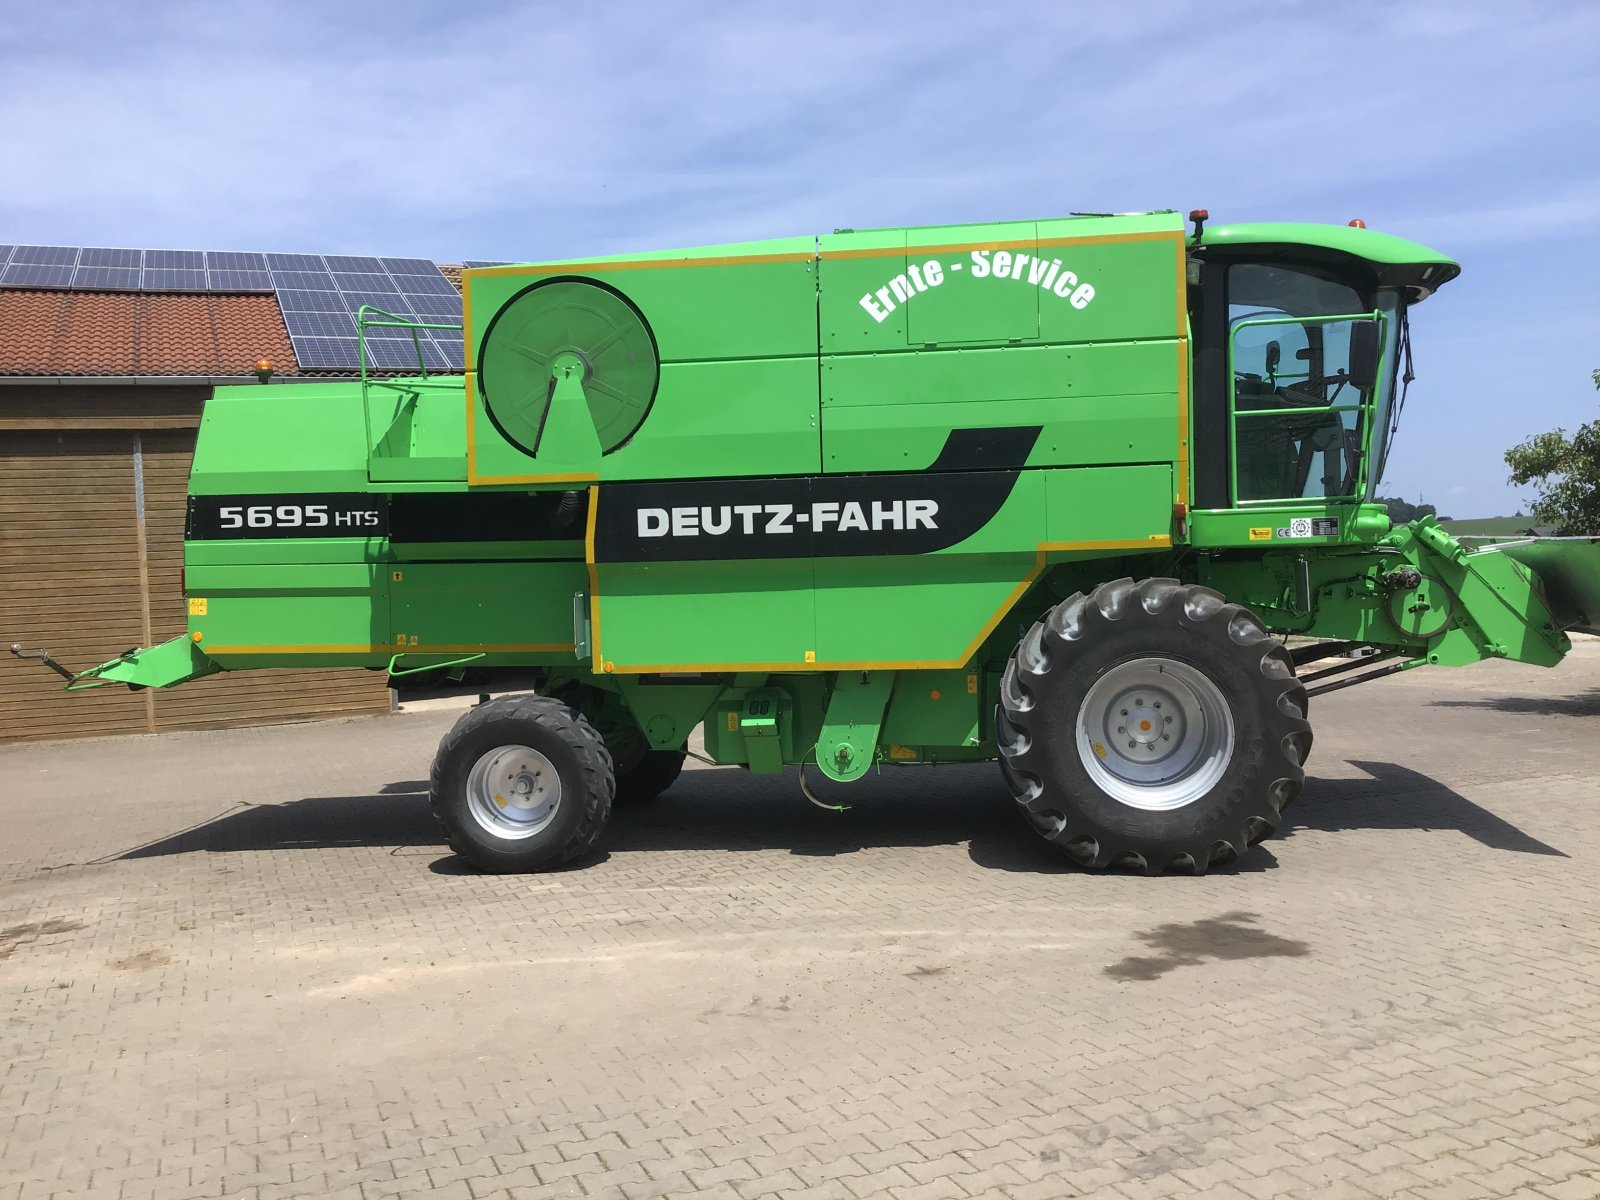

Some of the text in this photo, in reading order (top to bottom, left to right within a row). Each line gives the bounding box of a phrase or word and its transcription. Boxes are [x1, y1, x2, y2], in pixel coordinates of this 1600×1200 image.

[859, 259, 945, 324] Ernte
[970, 250, 1096, 310] Service
[219, 505, 379, 529] 5695 HTS
[636, 499, 939, 538] DEUTZ-FAHR
